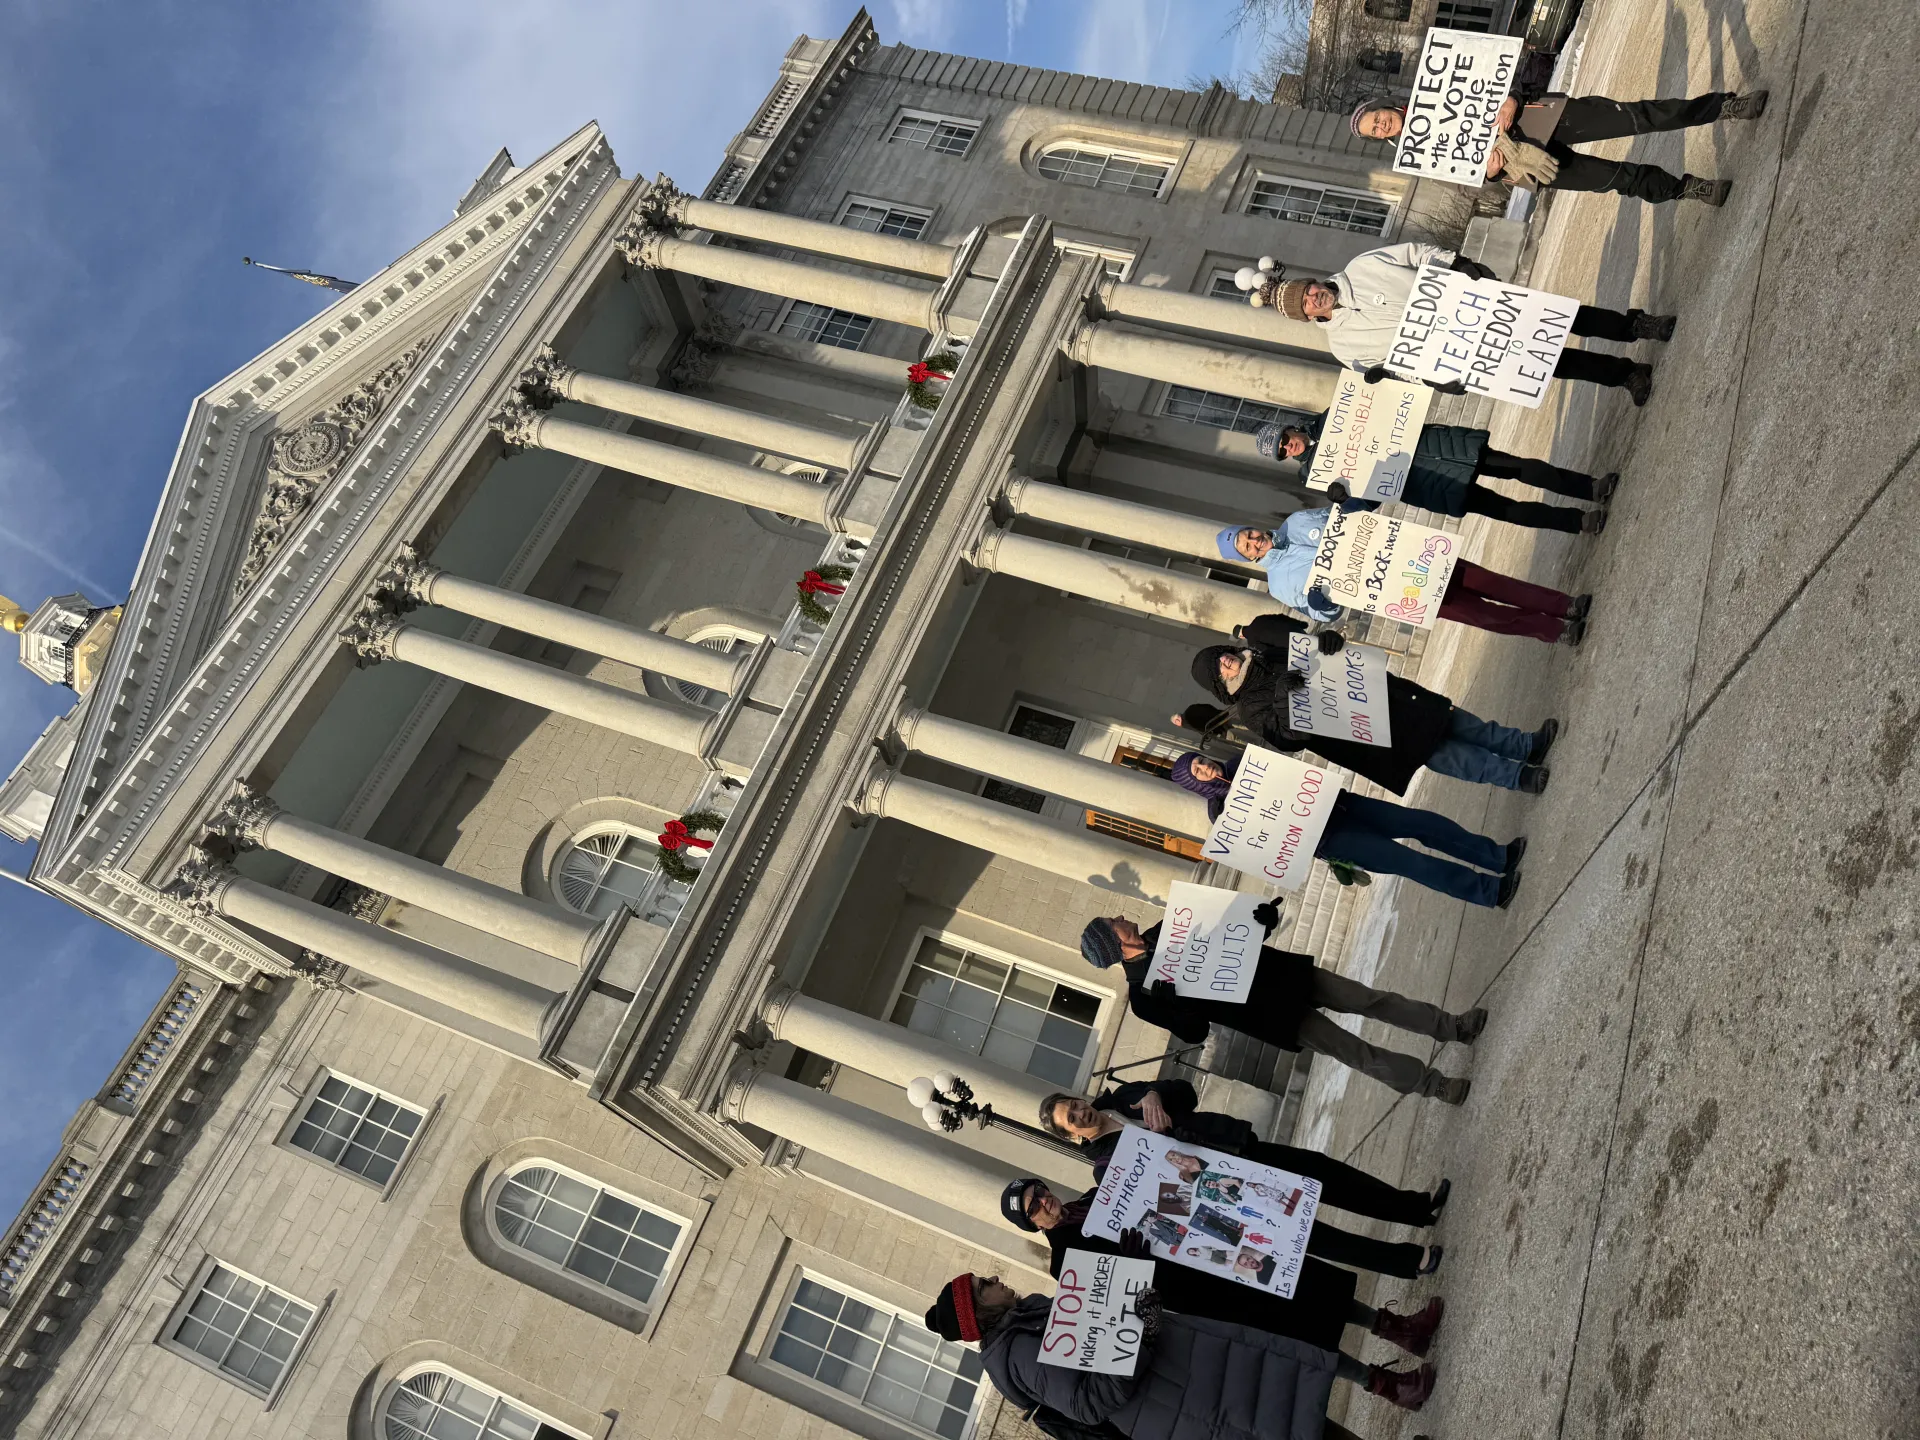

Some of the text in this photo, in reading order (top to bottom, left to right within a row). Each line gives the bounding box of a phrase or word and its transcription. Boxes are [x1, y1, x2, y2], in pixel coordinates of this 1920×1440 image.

[1399, 33, 1453, 170] PROTECT
[1431, 53, 1474, 159] the VOTE
[1451, 78, 1485, 161] people
[1471, 53, 1514, 165] education
[1388, 267, 1452, 370] FREEDOM
[1430, 315, 1449, 335] TO
[1433, 290, 1490, 374] TEACH
[1464, 290, 1528, 391] FREEDOM
[1505, 339, 1524, 357] TO
[1509, 307, 1571, 399] LEARN
[1310, 381, 1356, 484] Make VOTING
[1340, 388, 1375, 479] ACCESSIBLE
[1364, 436, 1379, 455] for
[1376, 391, 1415, 497] ALL CITIZENS
[1331, 514, 1379, 598] BANNING
[1368, 593, 1379, 601] a
[1384, 520, 1402, 550] worth
[1384, 535, 1452, 624] Reading
[1320, 671, 1339, 719] DON'T
[1345, 649, 1373, 743] BAN BOOKS
[1208, 754, 1269, 855] VACCINATE
[1246, 799, 1283, 850] for the
[1263, 769, 1324, 879] COMMON GOOD
[1156, 907, 1193, 983] VACCINES
[1182, 933, 1211, 983] CAUSE
[1209, 923, 1250, 992] ADULTS
[1096, 1165, 1126, 1206] Which
[1299, 1217, 1310, 1233] we
[1280, 1257, 1298, 1278] this
[1290, 1233, 1306, 1254] who
[1042, 1268, 1087, 1358] STOP
[1078, 1255, 1113, 1367] Making it HARDER
[1111, 1278, 1148, 1363] VOTE
[1275, 1282, 1291, 1297] Is
